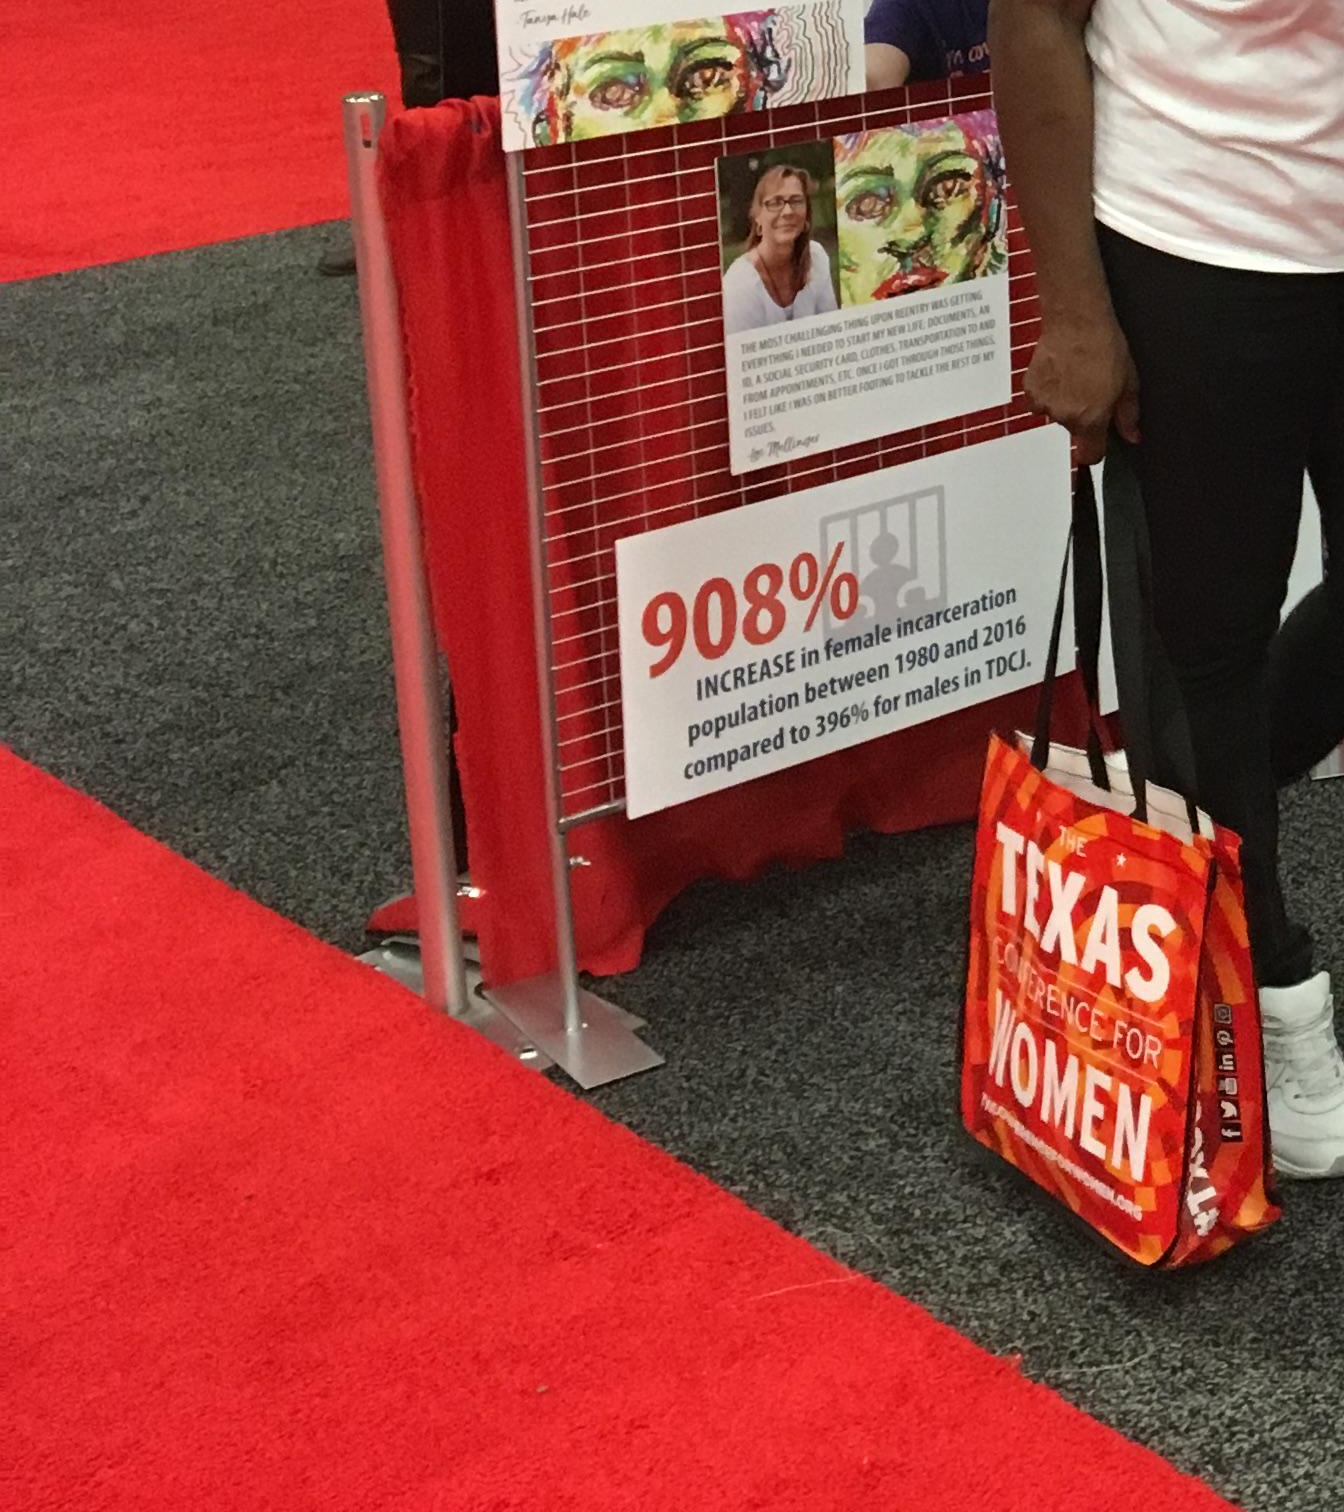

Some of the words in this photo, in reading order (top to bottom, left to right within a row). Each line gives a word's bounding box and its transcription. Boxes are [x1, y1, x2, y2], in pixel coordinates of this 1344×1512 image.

[641, 542, 859, 678] 908%
[697, 650, 795, 700] INCREASE
[801, 647, 819, 668] in
[824, 624, 891, 660] female
[897, 588, 1016, 638] incarceration
[684, 726, 784, 779] compared
[789, 725, 810, 744] to
[815, 702, 868, 737] 396%
[873, 695, 900, 717] for
[905, 676, 959, 707] males
[965, 667, 980, 687] in
[985, 648, 1031, 679] TDCJ.
[688, 692, 799, 747] population
[805, 663, 889, 703] between
[895, 643, 939, 673] 1980
[944, 629, 977, 658] and
[983, 615, 1025, 646] 2016
[1059, 825, 1087, 857] THE
[996, 821, 1177, 1002] TEXAS
[993, 935, 1104, 1042] COERENCE
[1112, 1020, 1163, 1069] FOR
